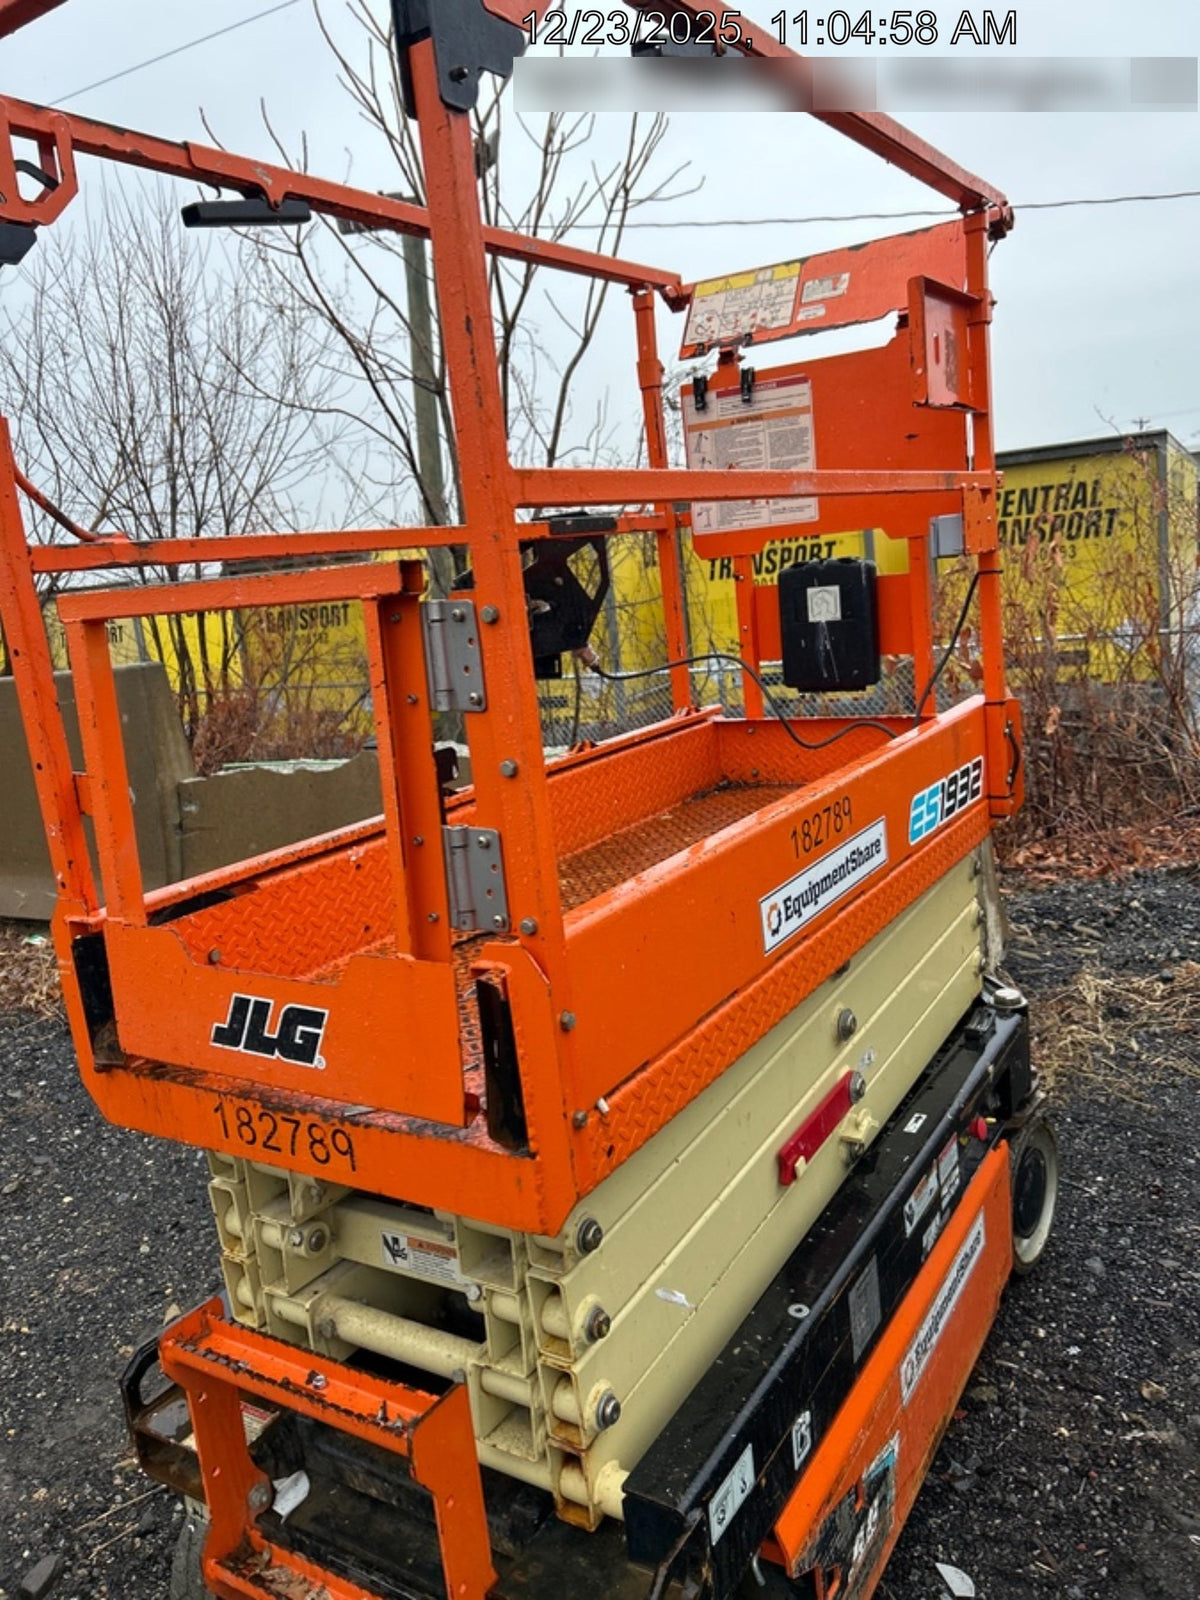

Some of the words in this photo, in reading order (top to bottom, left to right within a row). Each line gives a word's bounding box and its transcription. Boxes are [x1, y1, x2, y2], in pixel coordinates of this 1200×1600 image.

[996, 479, 1103, 518] ENTRAL
[997, 508, 1119, 545] ANSPORT
[708, 541, 837, 581] TRNSPORT
[258, 602, 349, 633] RANSPORT
[790, 796, 853, 859] 182789
[910, 758, 984, 844] ES1932
[783, 838, 882, 923] EquipmentShare
[211, 993, 328, 1066] JLG
[213, 1102, 356, 1172] 182789
